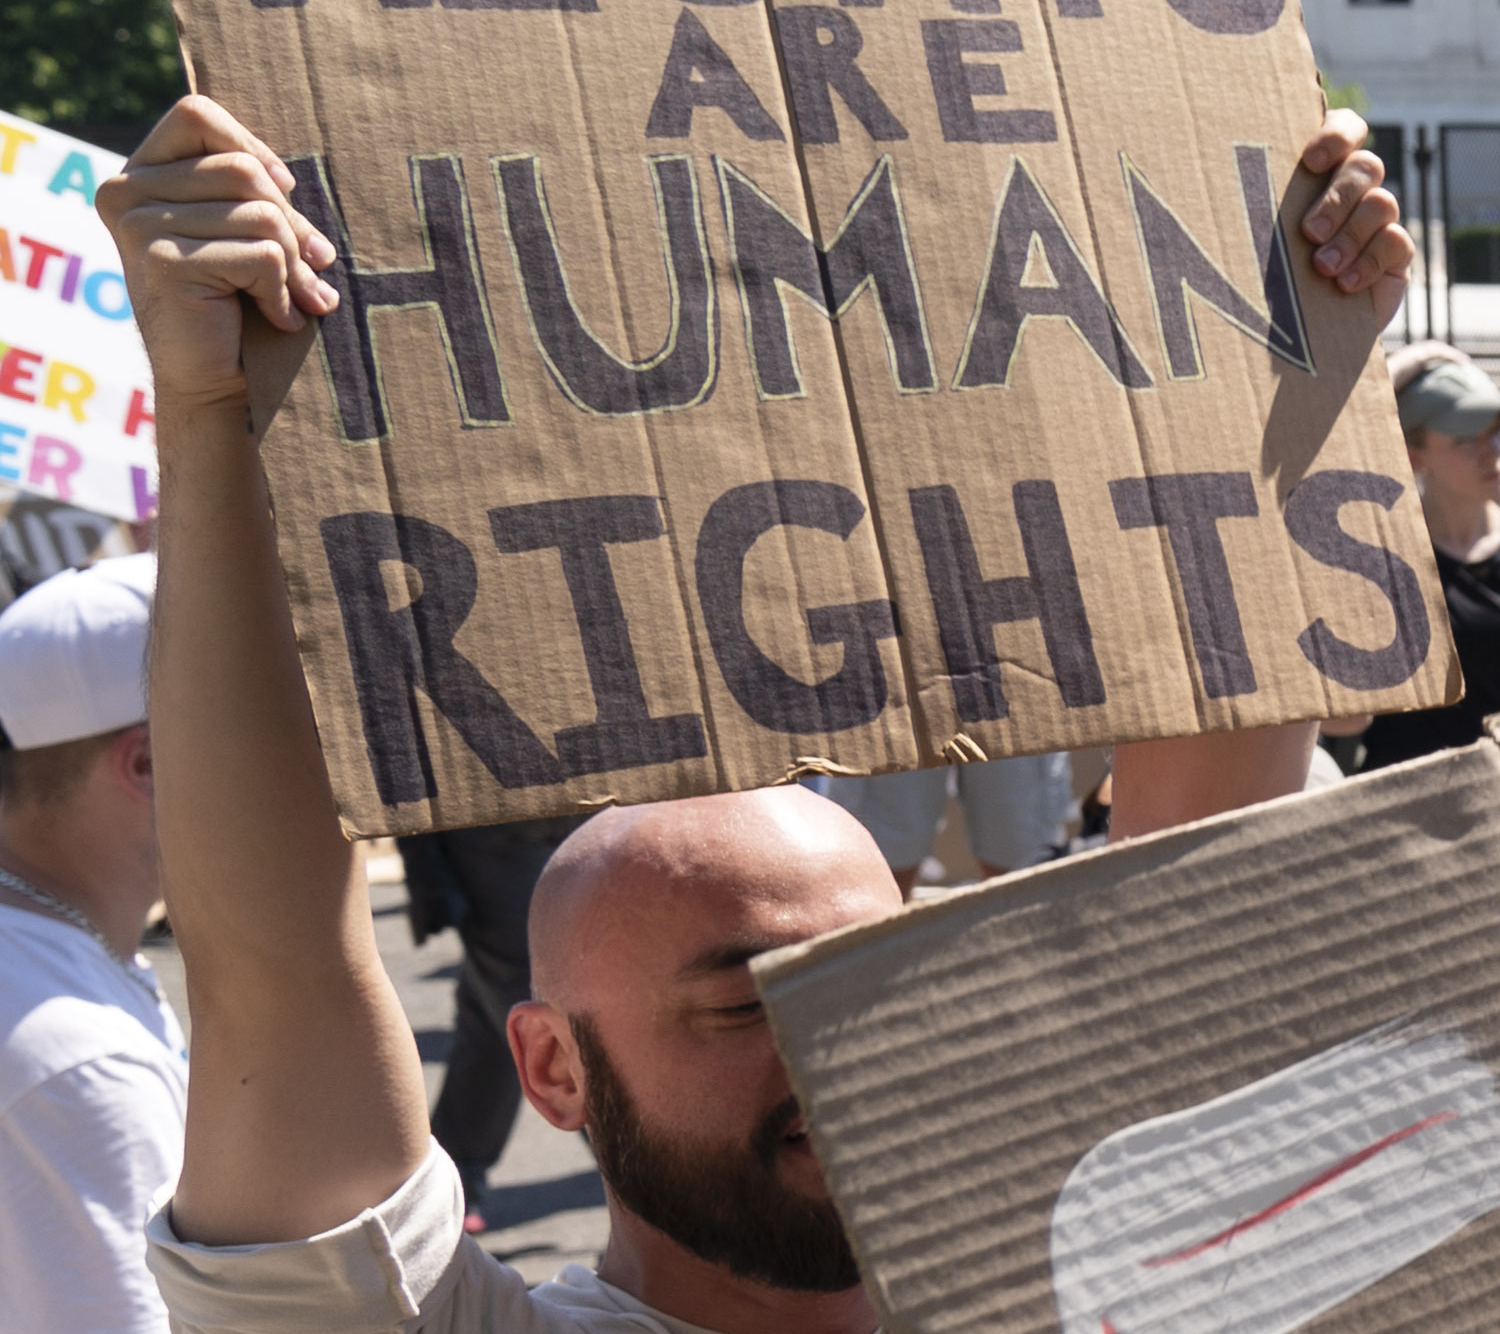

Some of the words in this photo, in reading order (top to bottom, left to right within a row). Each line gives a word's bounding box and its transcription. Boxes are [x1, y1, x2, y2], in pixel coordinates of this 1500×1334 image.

[644, 5, 1058, 146] ARE
[281, 142, 1316, 444] HUMAN
[319, 468, 1433, 807] RIGHTS
